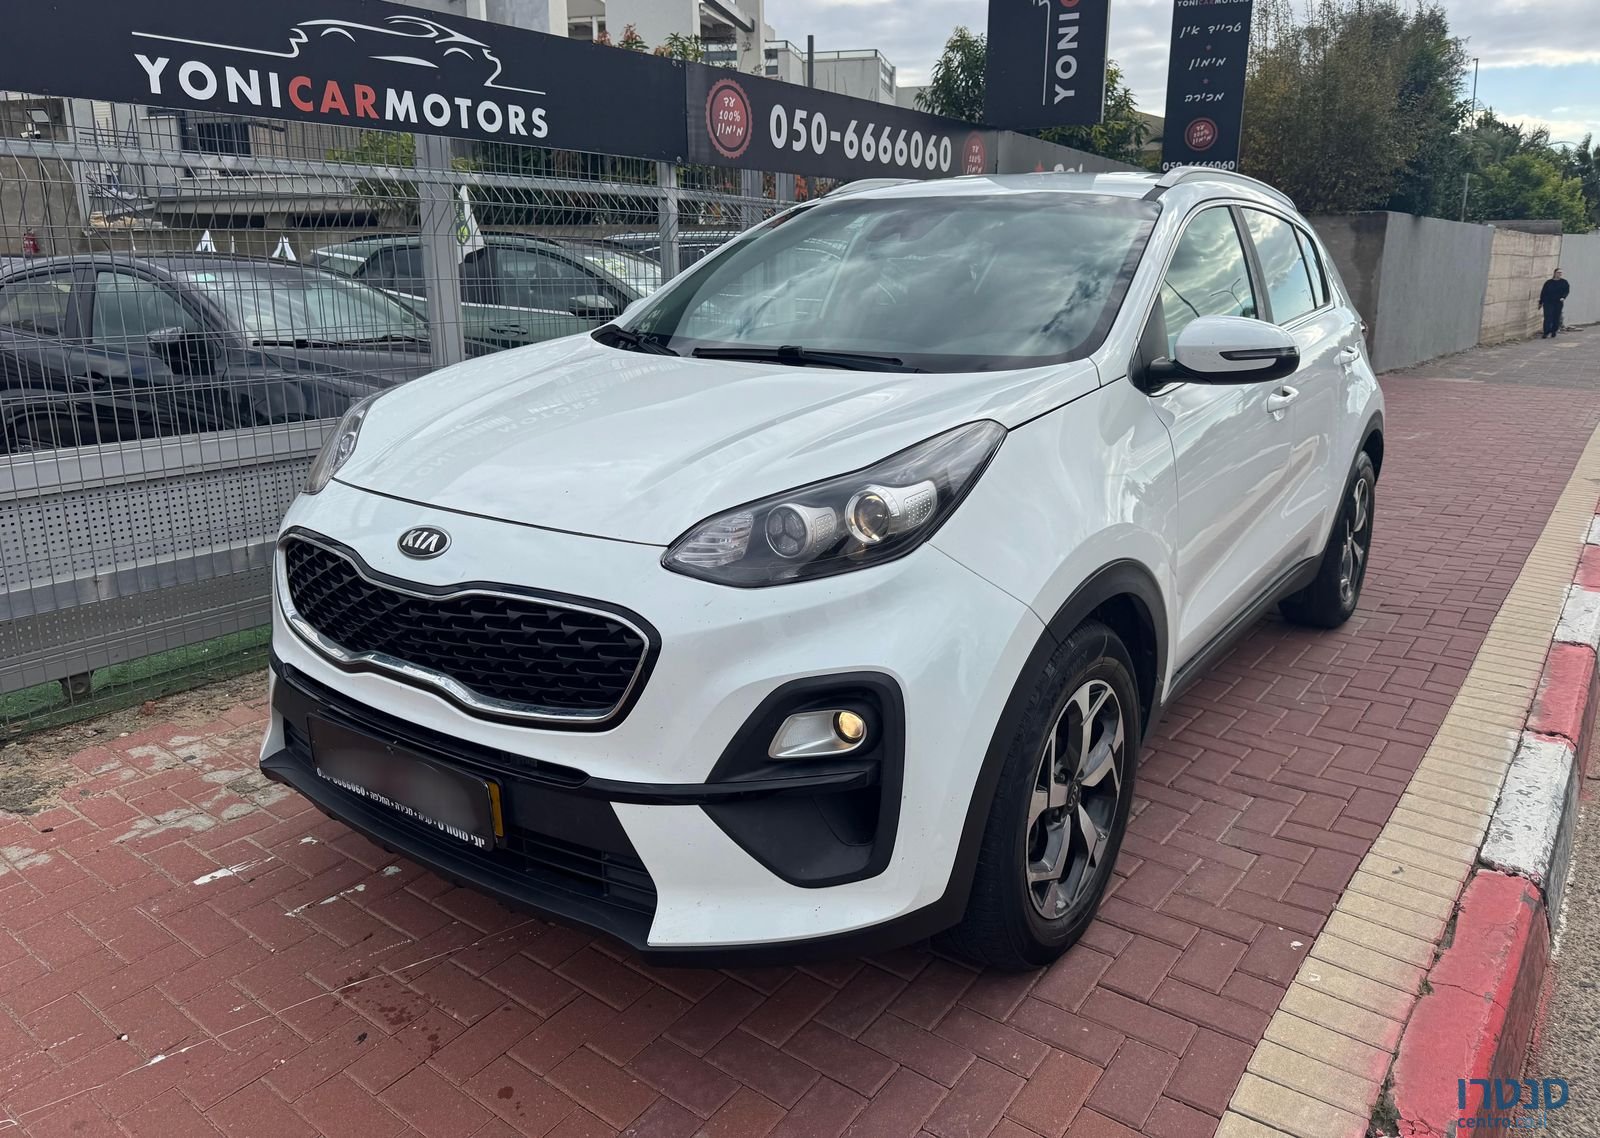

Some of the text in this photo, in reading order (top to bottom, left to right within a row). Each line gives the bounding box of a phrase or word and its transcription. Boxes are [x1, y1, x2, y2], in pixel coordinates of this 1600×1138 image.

[1180, 22, 1242, 39] טרייד אין
[1188, 57, 1227, 71] מימון
[723, 96, 736, 107] עד
[1184, 92, 1225, 103] מכירה
[719, 109, 741, 122] 100%
[716, 122, 744, 137] מימון
[769, 104, 952, 172] 050-6666060
[402, 529, 440, 553] KIA
